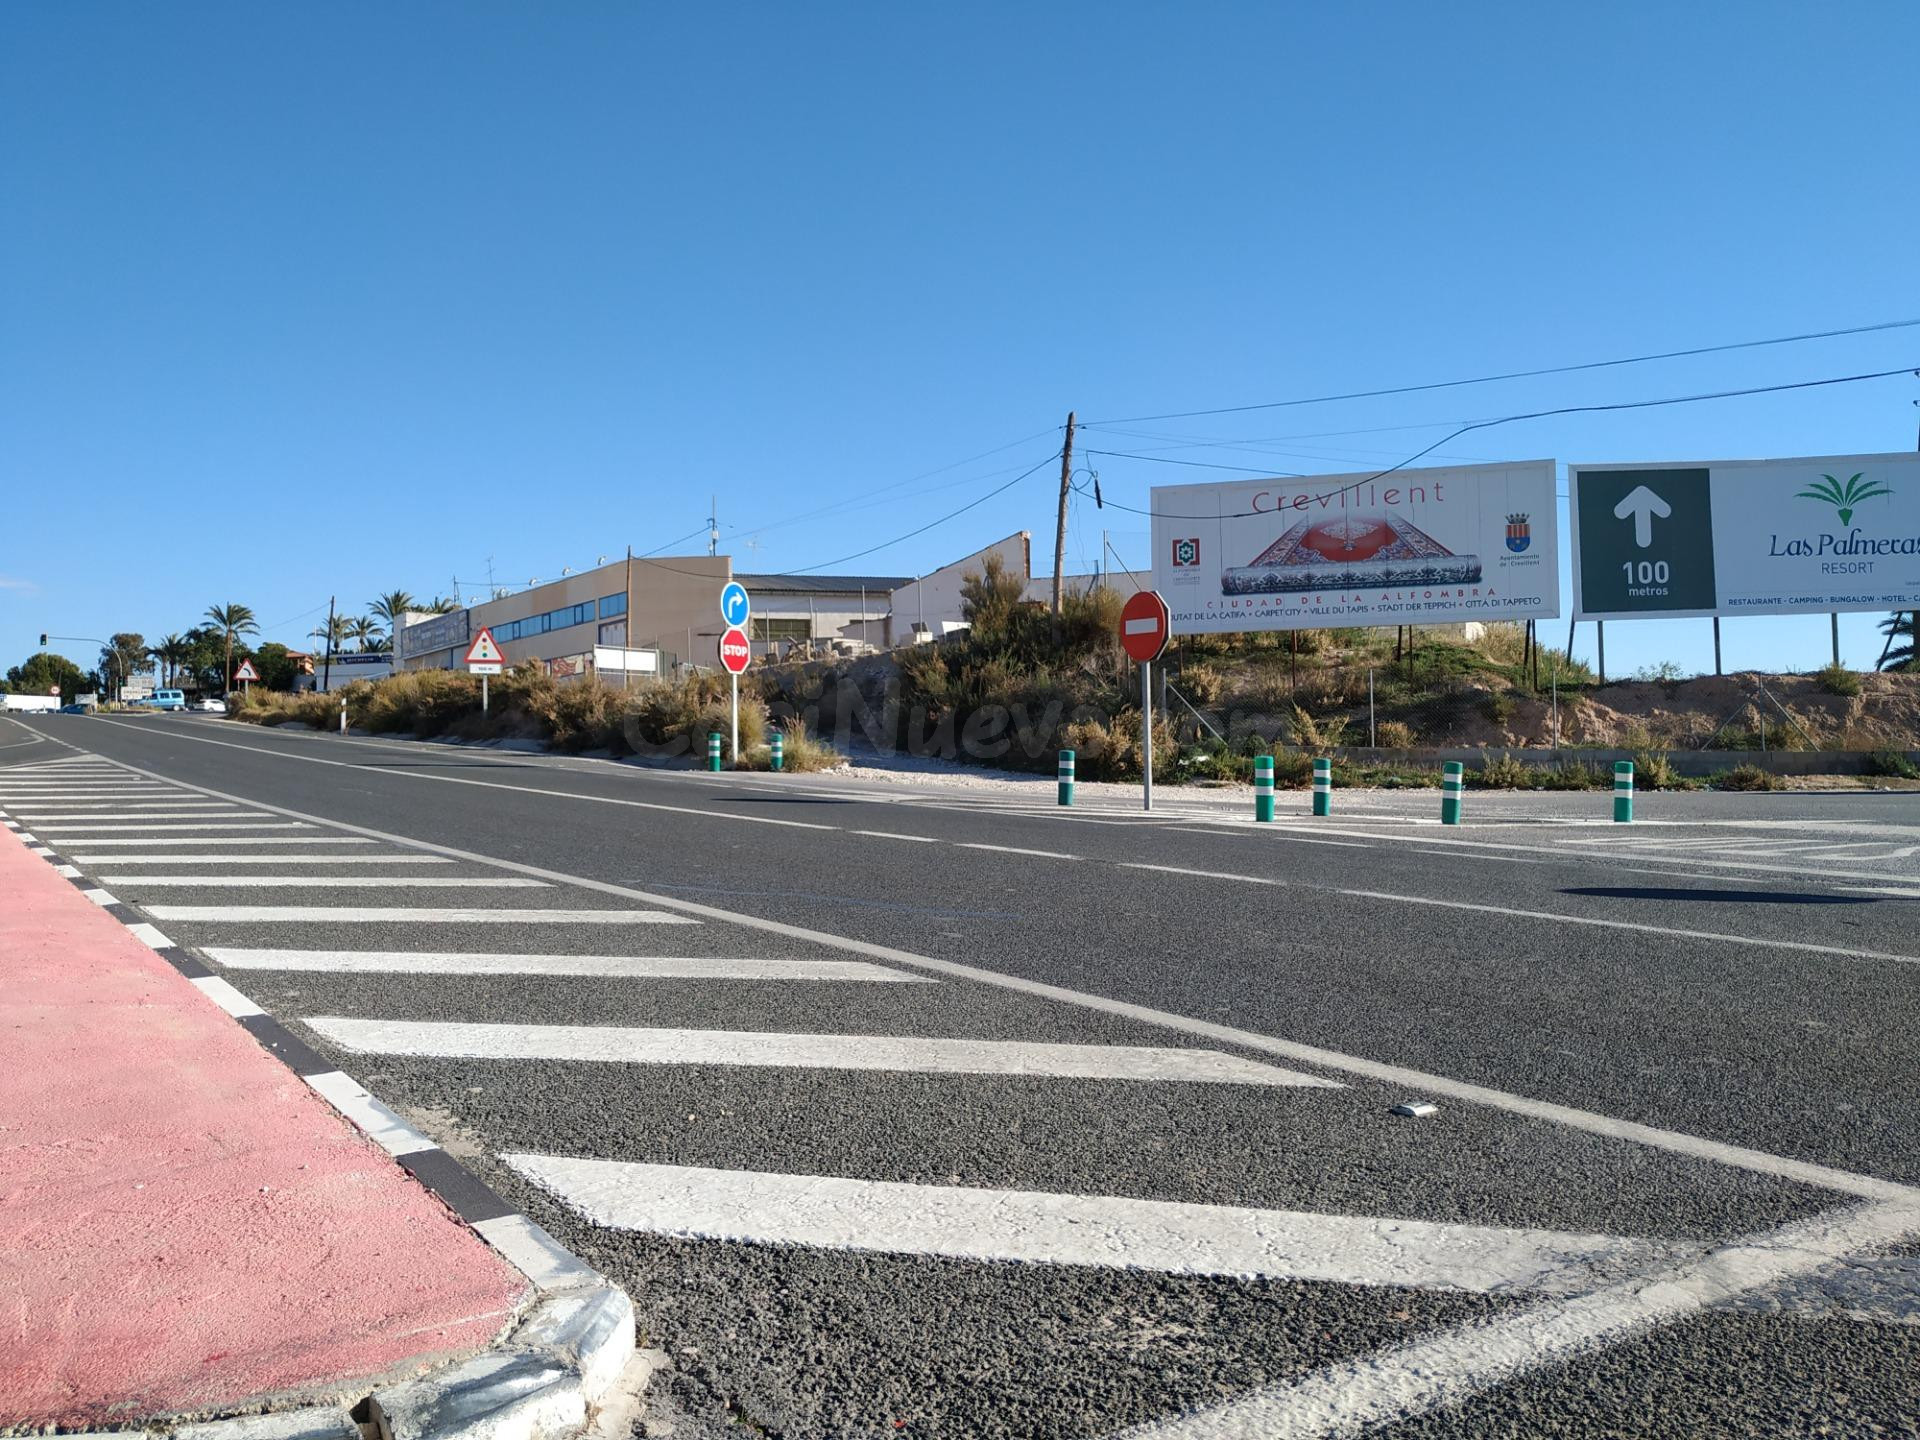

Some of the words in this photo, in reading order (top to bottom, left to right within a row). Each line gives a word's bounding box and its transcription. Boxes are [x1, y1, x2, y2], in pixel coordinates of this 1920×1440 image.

[1252, 482, 1444, 513] Crevillent
[1768, 534, 1813, 557] Las
[1623, 560, 1669, 585] 100
[1821, 561, 1874, 574] RESORT
[1206, 597, 1283, 609] CIUDAD
[1301, 595, 1322, 605] DE
[1341, 594, 1361, 603] LA
[1381, 587, 1496, 601] ALFOMBRA
[1628, 586, 1669, 596] metros
[1728, 598, 1782, 606] RESTAURANTE
[1788, 597, 1824, 605] CAMPING
[1830, 596, 1875, 604] BUNGALOW
[1881, 595, 1907, 603] HOTEL
[1171, 612, 1192, 621] IUTAT
[1194, 612, 1205, 621] DE
[1206, 611, 1217, 620] LA
[1219, 610, 1246, 620] CATIFA
[1254, 607, 1285, 618] CARPET
[1284, 607, 1301, 616] CITY
[1309, 605, 1330, 615] VILLE
[1332, 605, 1345, 614] DU
[1346, 604, 1369, 614] TAPIS
[1377, 603, 1404, 613] STADT
[1405, 602, 1421, 612] DER
[1423, 601, 1457, 610] TEPPICH
[1491, 599, 1500, 607] DI
[1501, 596, 1542, 607] TAPPETO
[724, 644, 748, 657] STOP
